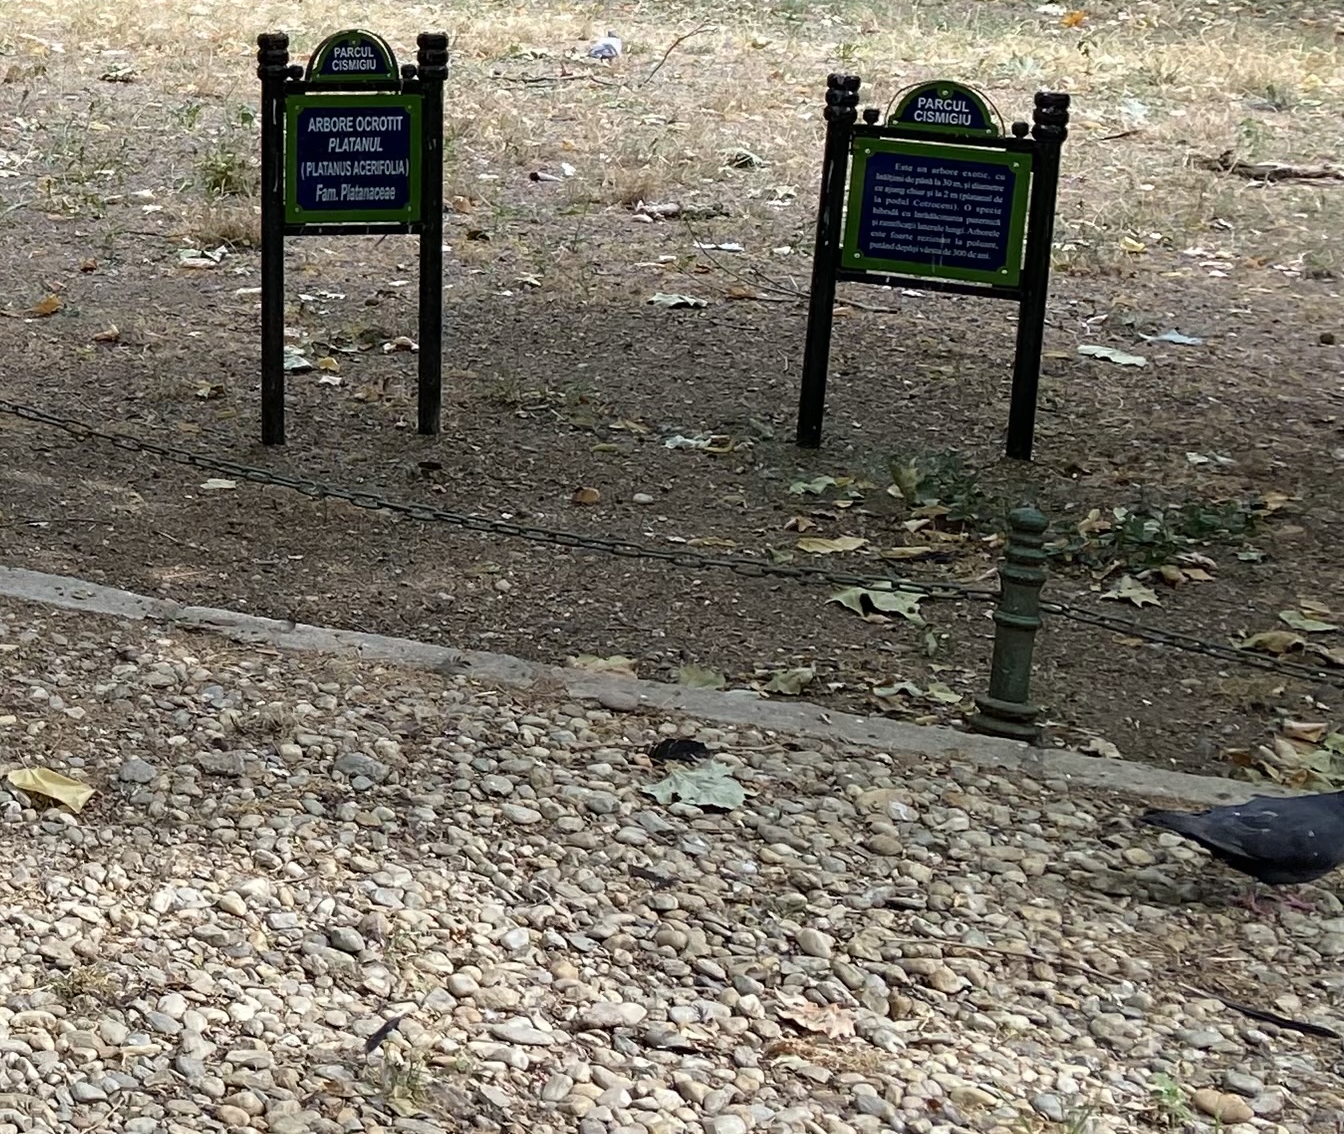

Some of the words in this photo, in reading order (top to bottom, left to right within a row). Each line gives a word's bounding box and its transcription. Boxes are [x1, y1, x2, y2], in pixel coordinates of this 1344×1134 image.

[334, 46, 374, 58] PARCUL
[332, 59, 376, 71] CISMIGIU
[918, 97, 969, 112] PARCUL
[308, 116, 354, 132] ARBORE
[356, 116, 403, 132] OCROTIT
[914, 110, 972, 126] CISMIGIU
[328, 137, 383, 152] PLATANUL
[352, 159, 409, 176] ACERIFOLIA)
[942, 179, 952, 187] 30
[316, 184, 338, 202] Fam.
[340, 184, 396, 200] Platanaceae
[943, 190, 949, 198] 2
